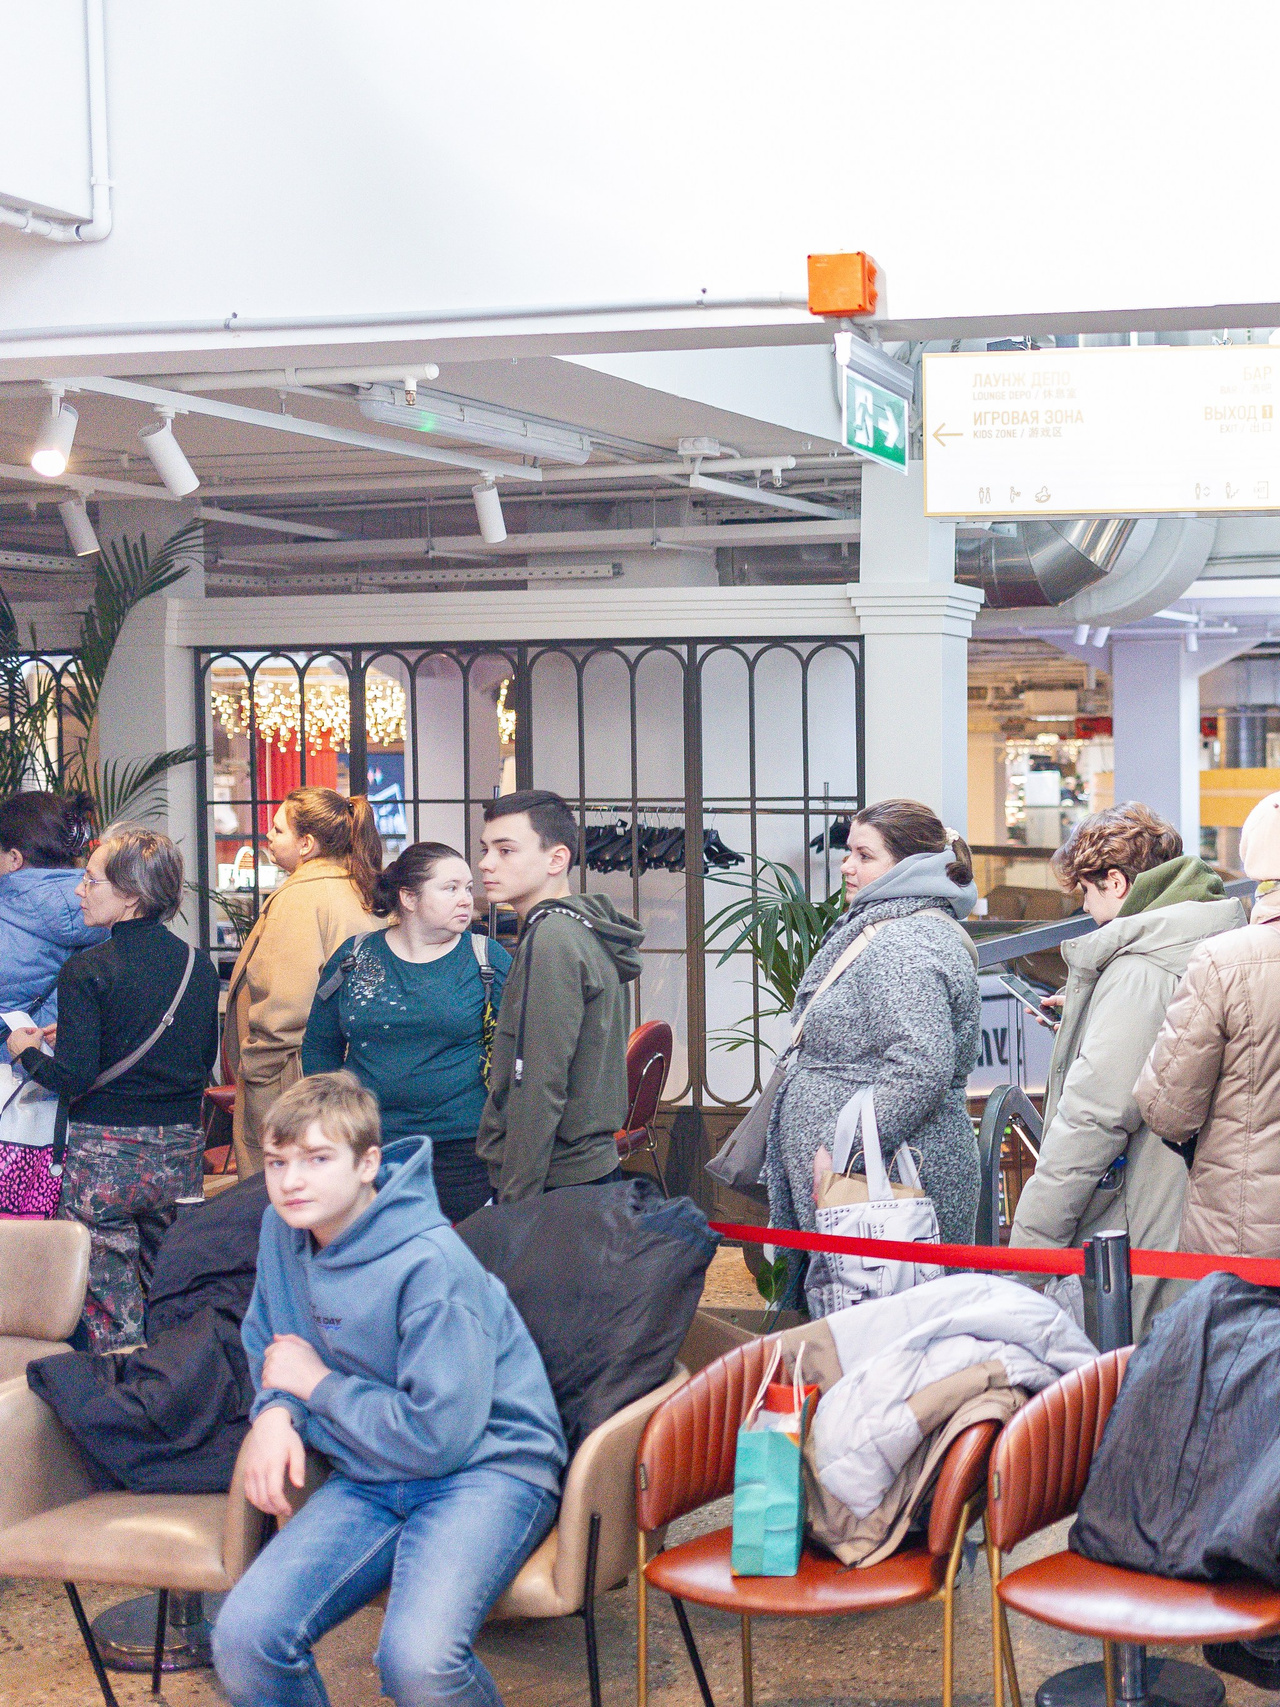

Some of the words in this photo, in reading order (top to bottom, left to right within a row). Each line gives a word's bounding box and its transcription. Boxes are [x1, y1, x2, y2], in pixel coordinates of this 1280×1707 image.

[972, 372, 1026, 388] ЛАУНЖ
[1031, 371, 1071, 389] ДЕПО
[1243, 366, 1272, 381] БАР
[972, 390, 1006, 401] LOUNGE
[1009, 390, 1032, 400] DEPO
[973, 410, 1039, 426] ИГРОВАЯ
[1044, 409, 1084, 425] ЗОНА
[1204, 405, 1258, 422] ВЫХОД
[972, 429, 993, 439] KIDS
[995, 428, 1017, 439] ZONE
[1219, 423, 1238, 433] EXIT
